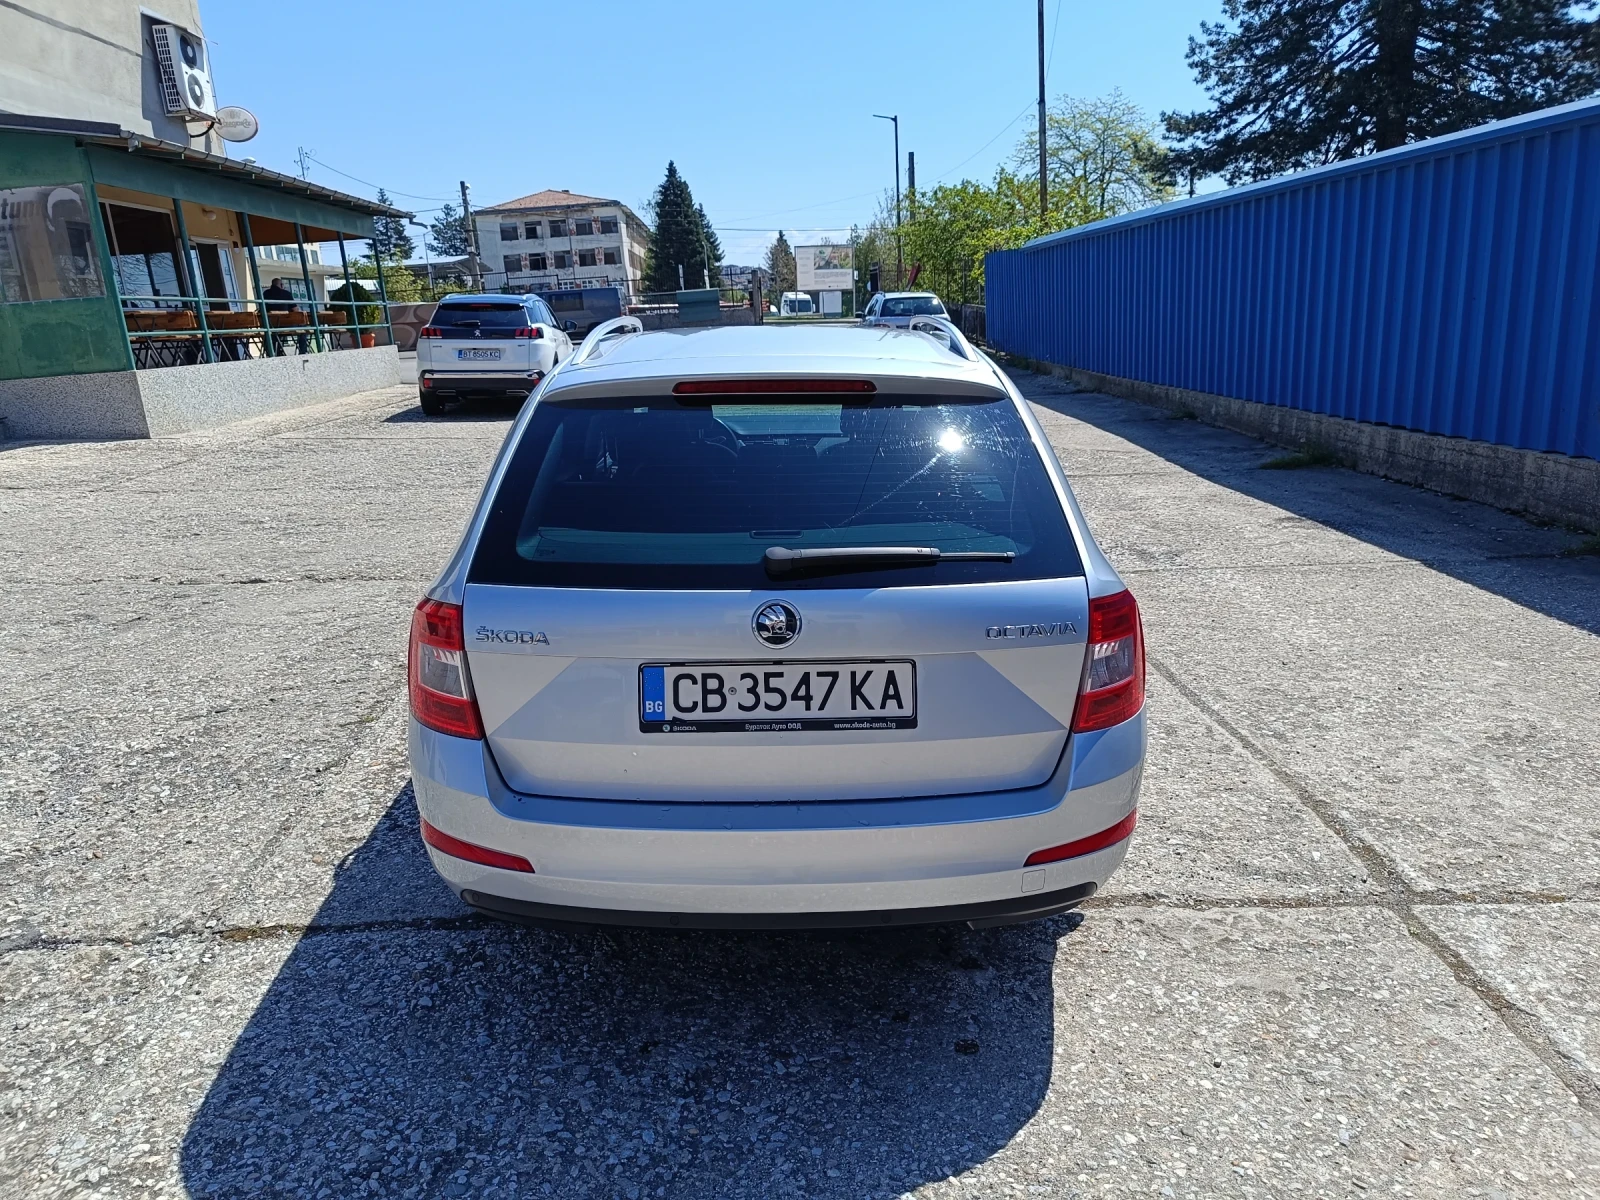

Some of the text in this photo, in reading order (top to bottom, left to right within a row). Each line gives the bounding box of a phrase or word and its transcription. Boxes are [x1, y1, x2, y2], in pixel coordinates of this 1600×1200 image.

[475, 625, 550, 646] ŠKODA
[985, 621, 1077, 640] OCTAVIA
[673, 670, 904, 713] CB 3547 KA
[645, 701, 663, 713] BG
[833, 721, 896, 729] www.skoda-auto.bg
